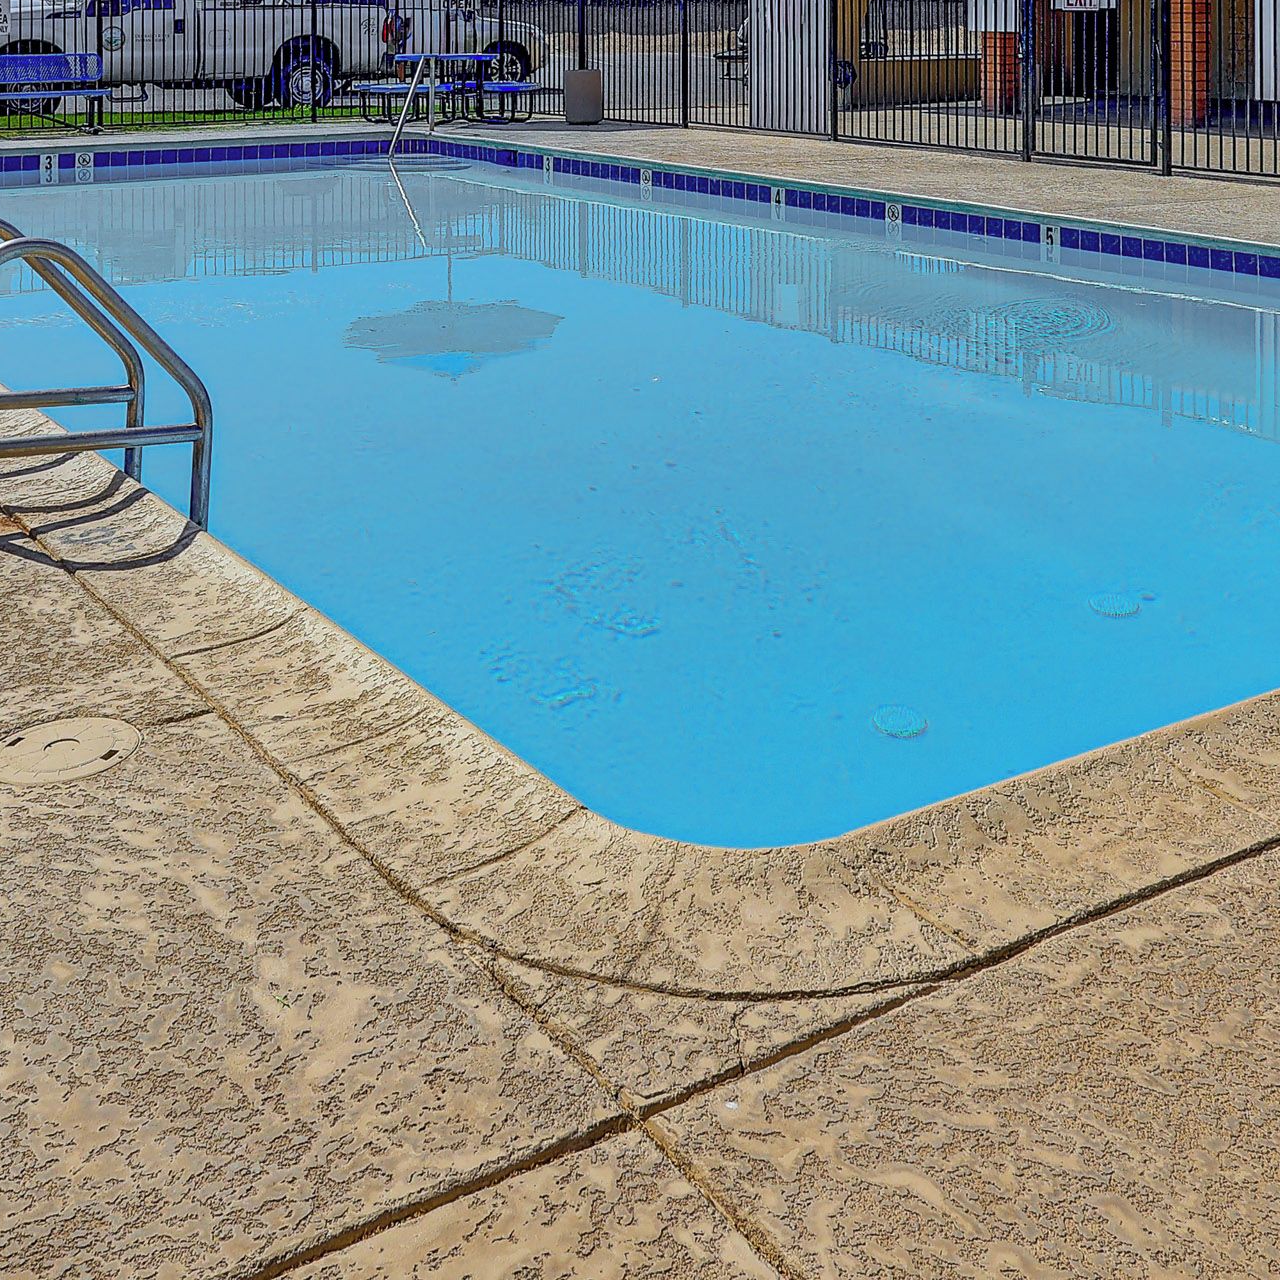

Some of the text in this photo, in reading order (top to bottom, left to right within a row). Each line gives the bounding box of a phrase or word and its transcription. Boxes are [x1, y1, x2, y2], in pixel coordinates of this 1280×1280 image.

[45, 155, 53, 170] 3
[775, 188, 781, 205] 4
[1046, 226, 1054, 246] 5
